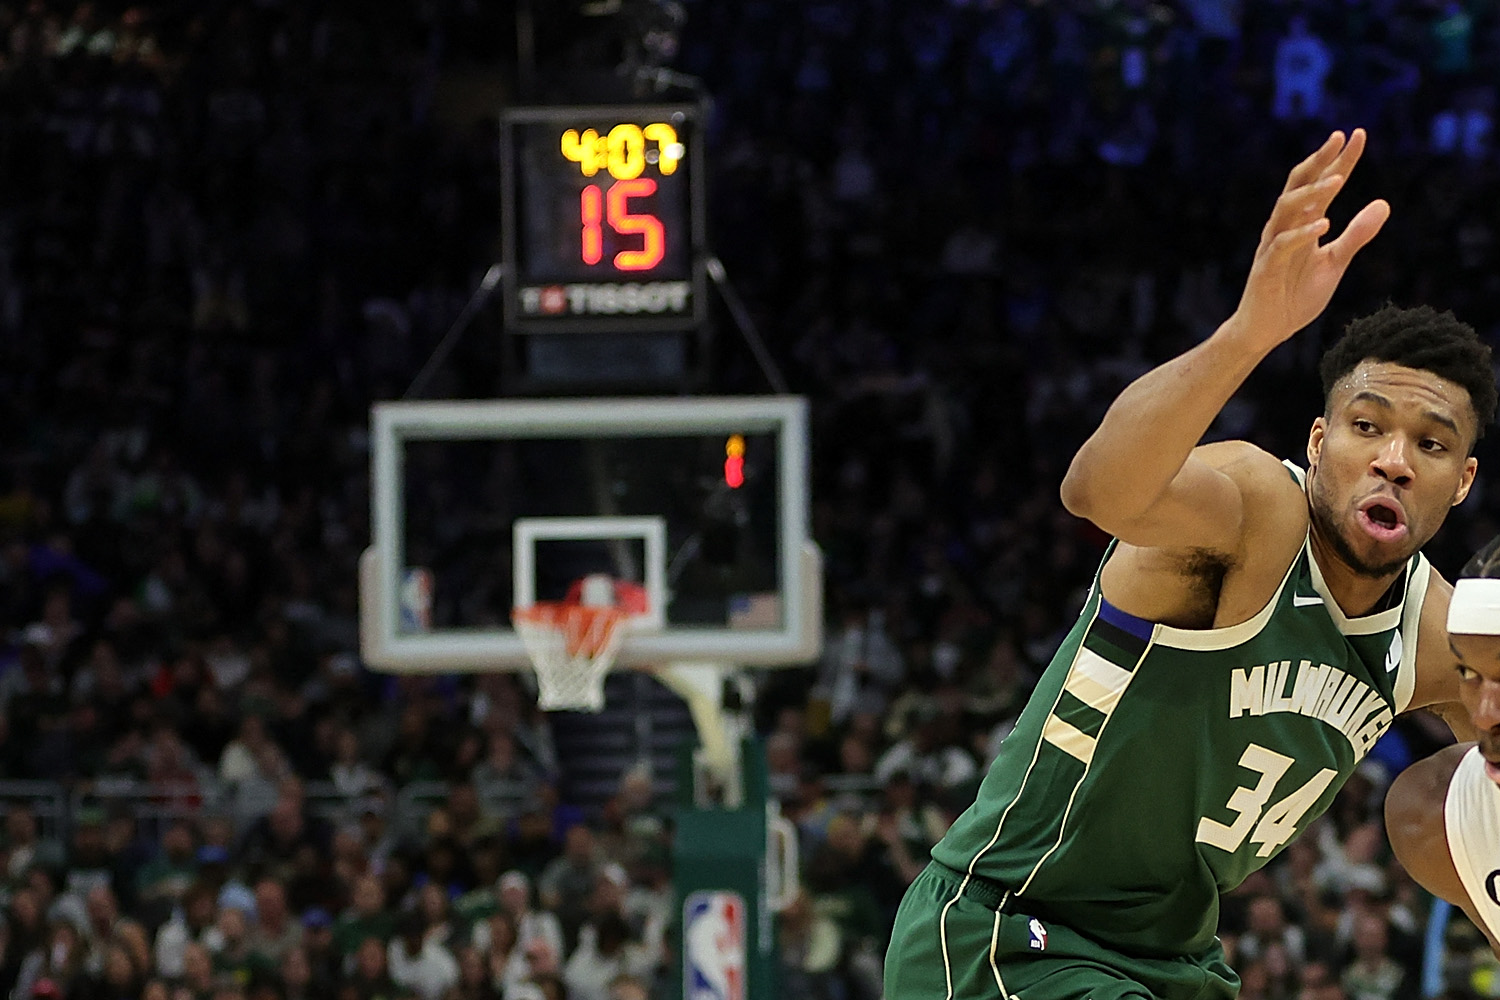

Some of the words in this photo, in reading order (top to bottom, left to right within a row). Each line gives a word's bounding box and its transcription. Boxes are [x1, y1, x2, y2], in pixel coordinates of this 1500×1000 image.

[561, 123, 679, 180] 4:07
[581, 178, 665, 271] 15
[567, 283, 689, 315] TISSOT
[1195, 743, 1338, 858] 34
